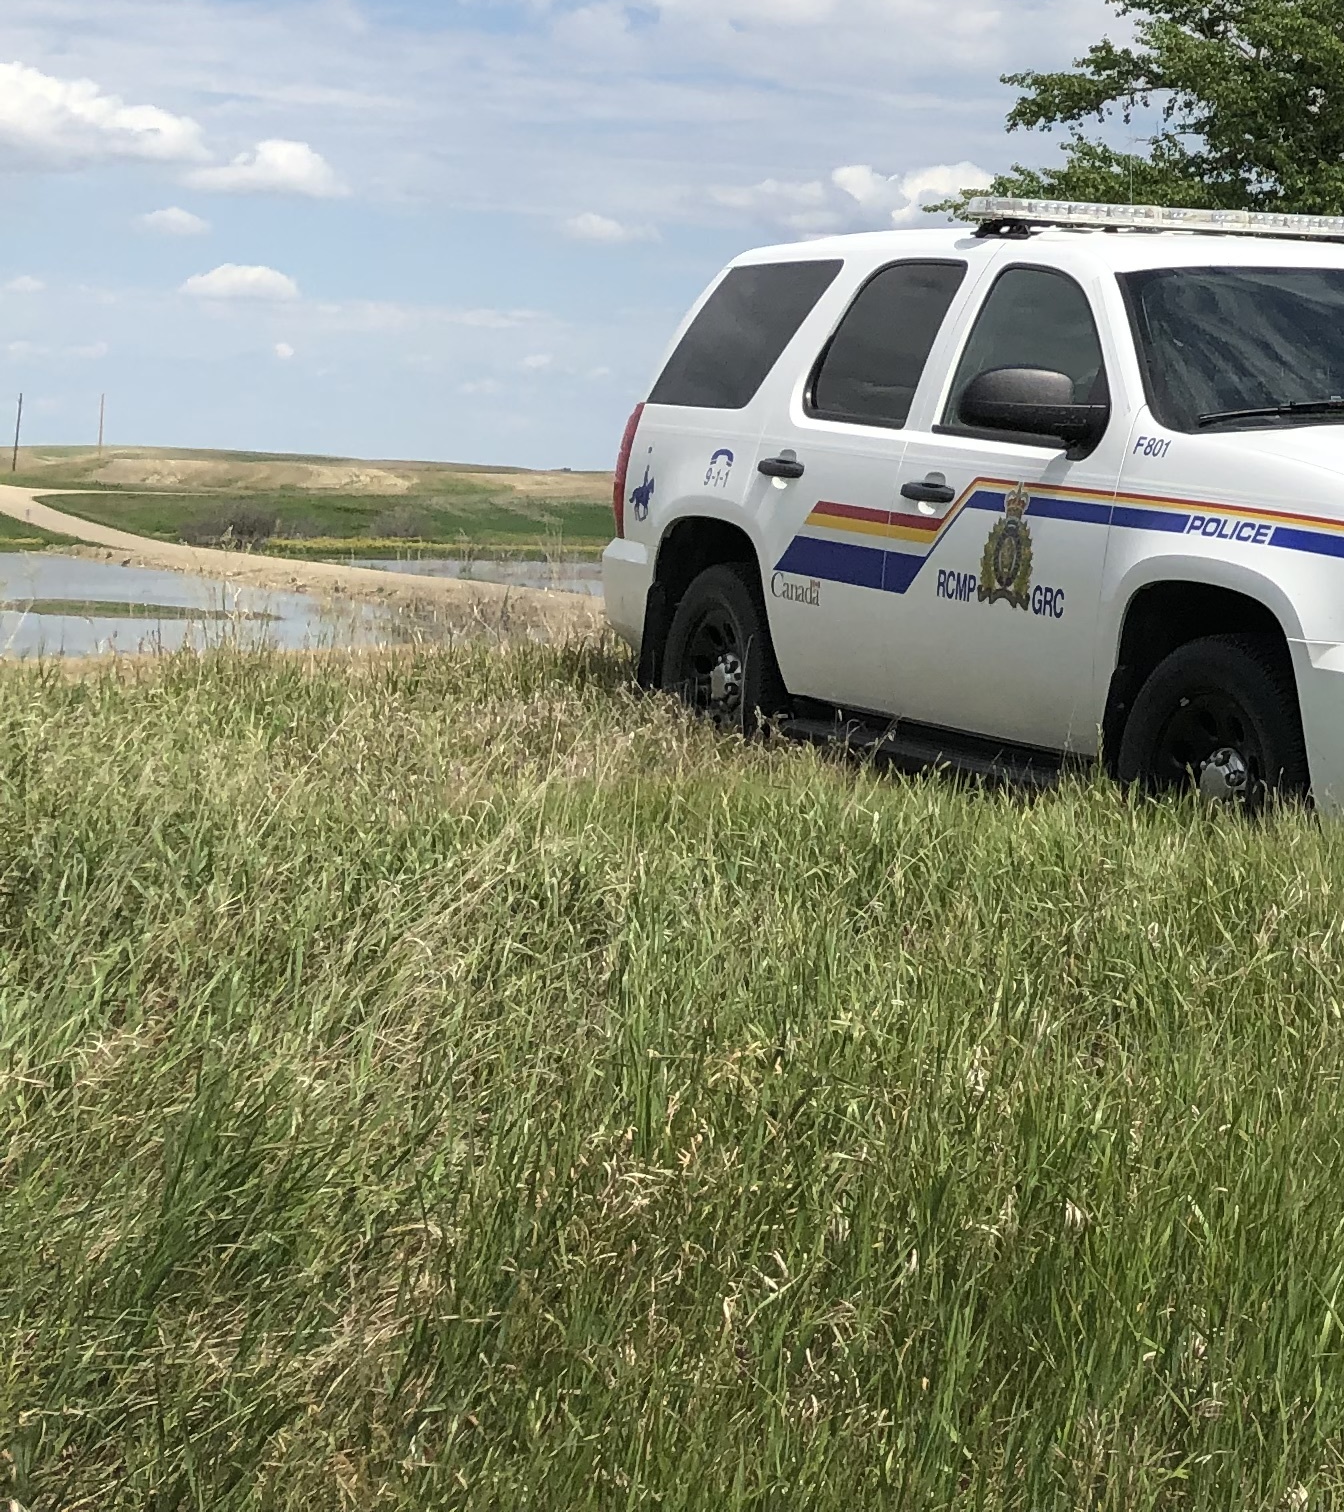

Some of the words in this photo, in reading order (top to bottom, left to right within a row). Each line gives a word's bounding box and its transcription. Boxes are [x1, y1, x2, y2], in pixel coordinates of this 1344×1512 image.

[1133, 436, 1172, 458] F801
[703, 467, 730, 488] 9-1-1
[1186, 515, 1272, 544] POLICE
[771, 571, 820, 607] Canada
[936, 569, 977, 602] RCMP
[1031, 585, 1065, 619] GRC
